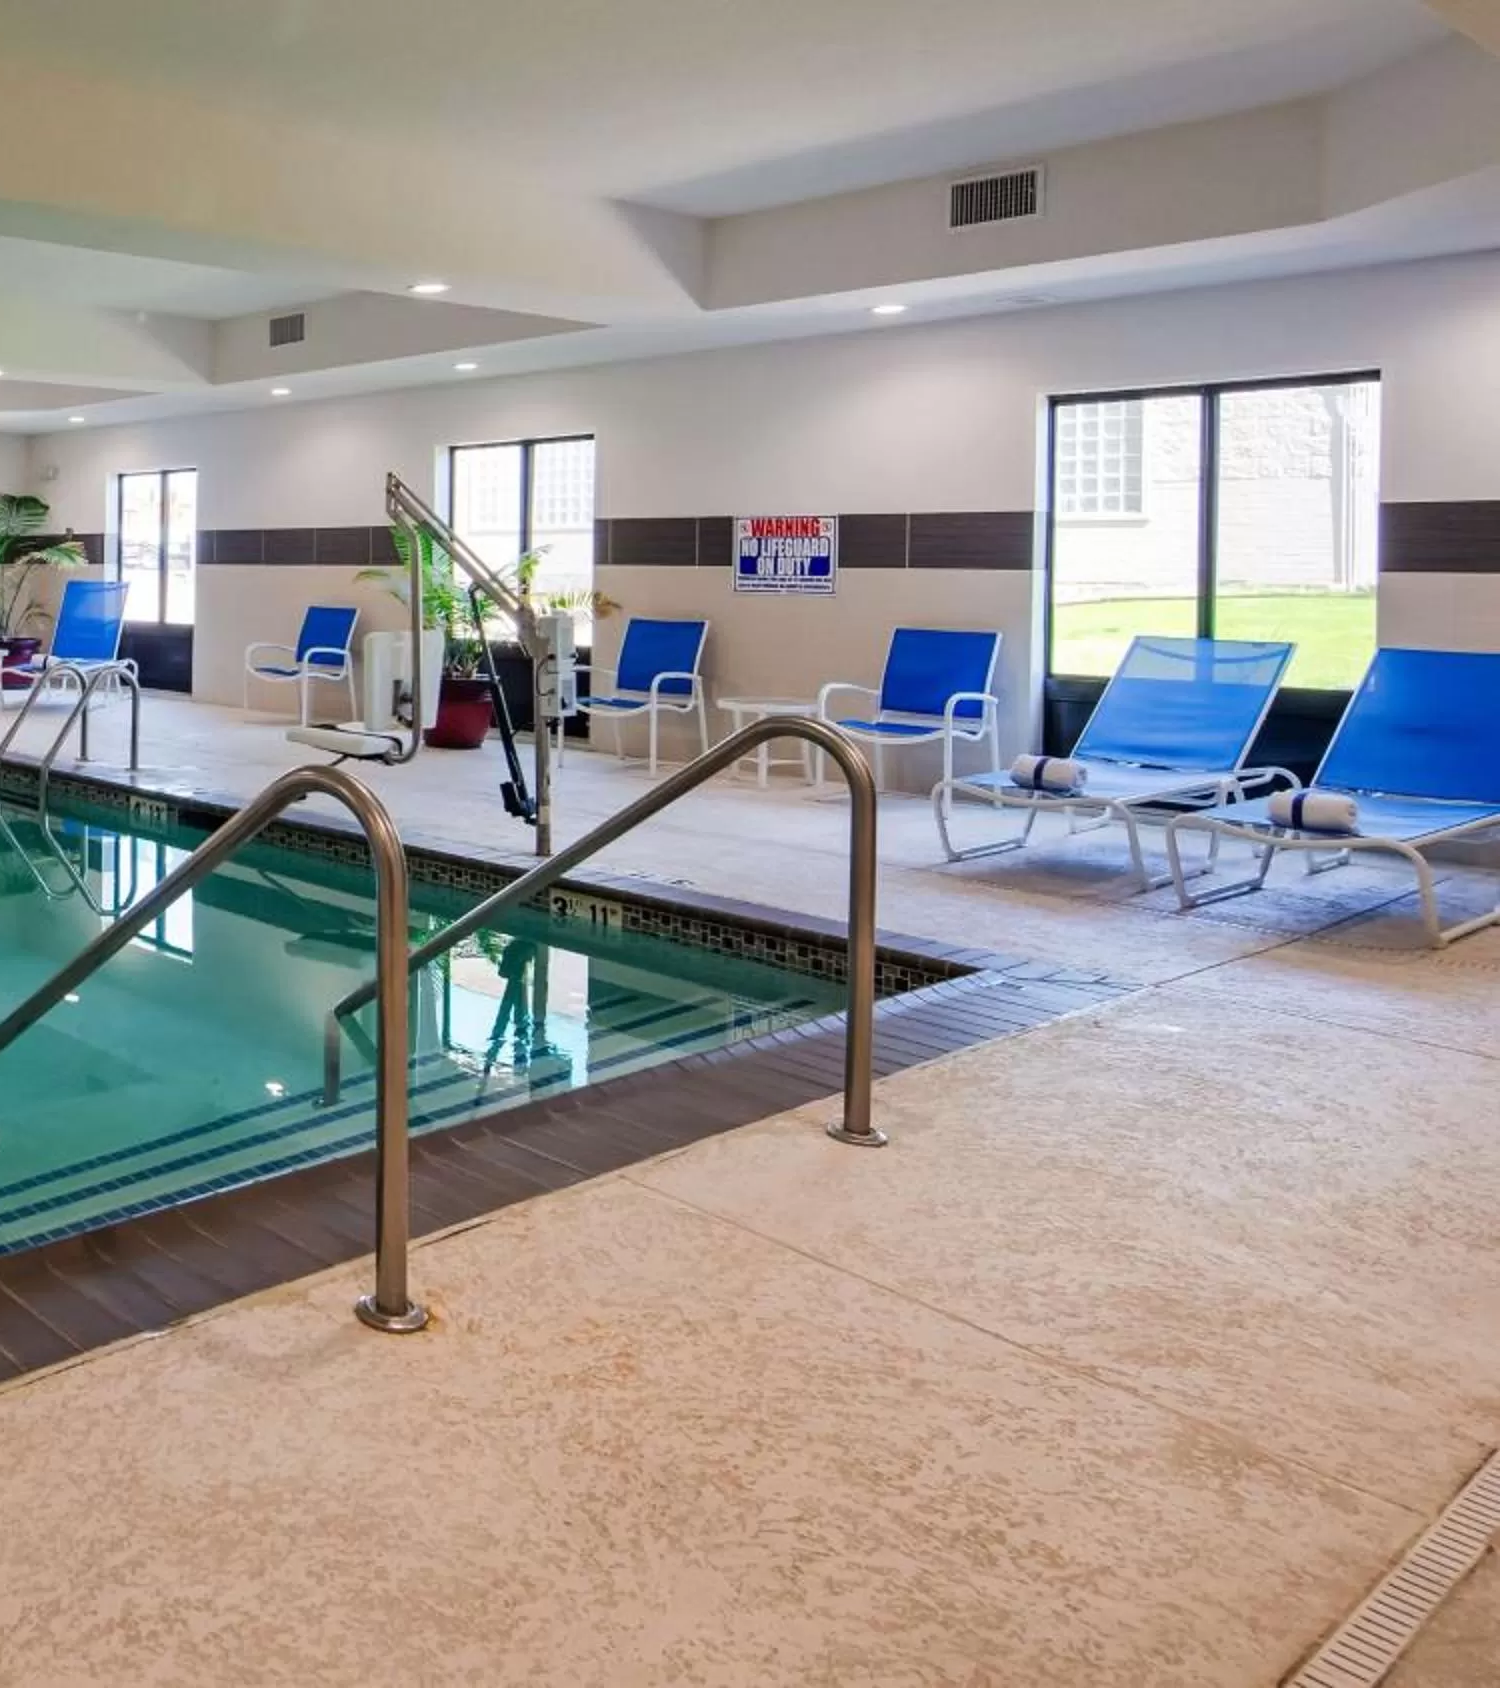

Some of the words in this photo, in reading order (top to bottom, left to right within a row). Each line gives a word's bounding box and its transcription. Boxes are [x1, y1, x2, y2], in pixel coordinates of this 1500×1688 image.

[749, 517, 821, 537] WARNING
[740, 538, 759, 557] NO
[761, 538, 830, 558] LIFEGUARD
[757, 557, 775, 575] ON
[777, 557, 811, 576] DUTY
